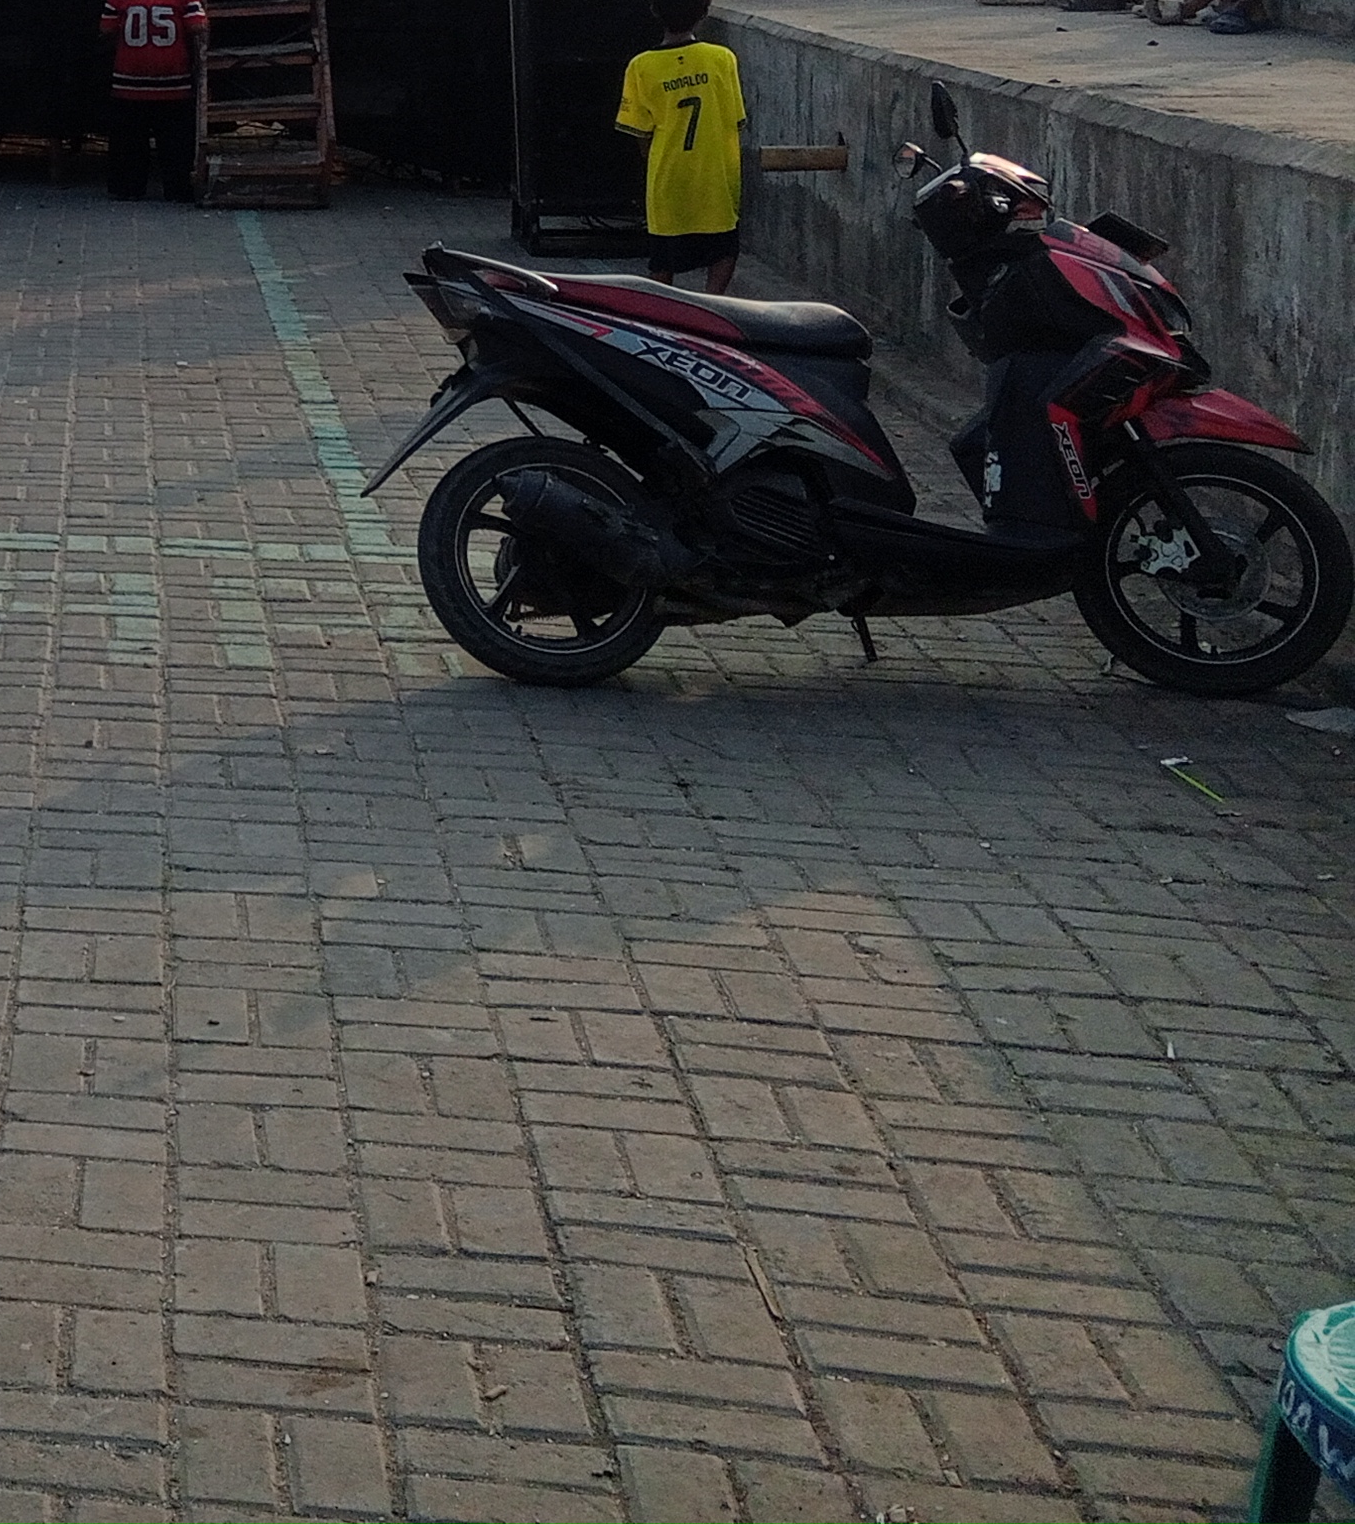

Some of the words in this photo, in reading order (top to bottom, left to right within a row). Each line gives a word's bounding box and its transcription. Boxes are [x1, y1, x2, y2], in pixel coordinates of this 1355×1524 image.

[124, 5, 177, 48] 05
[662, 73, 709, 93] RONALDO
[677, 96, 702, 151] 7
